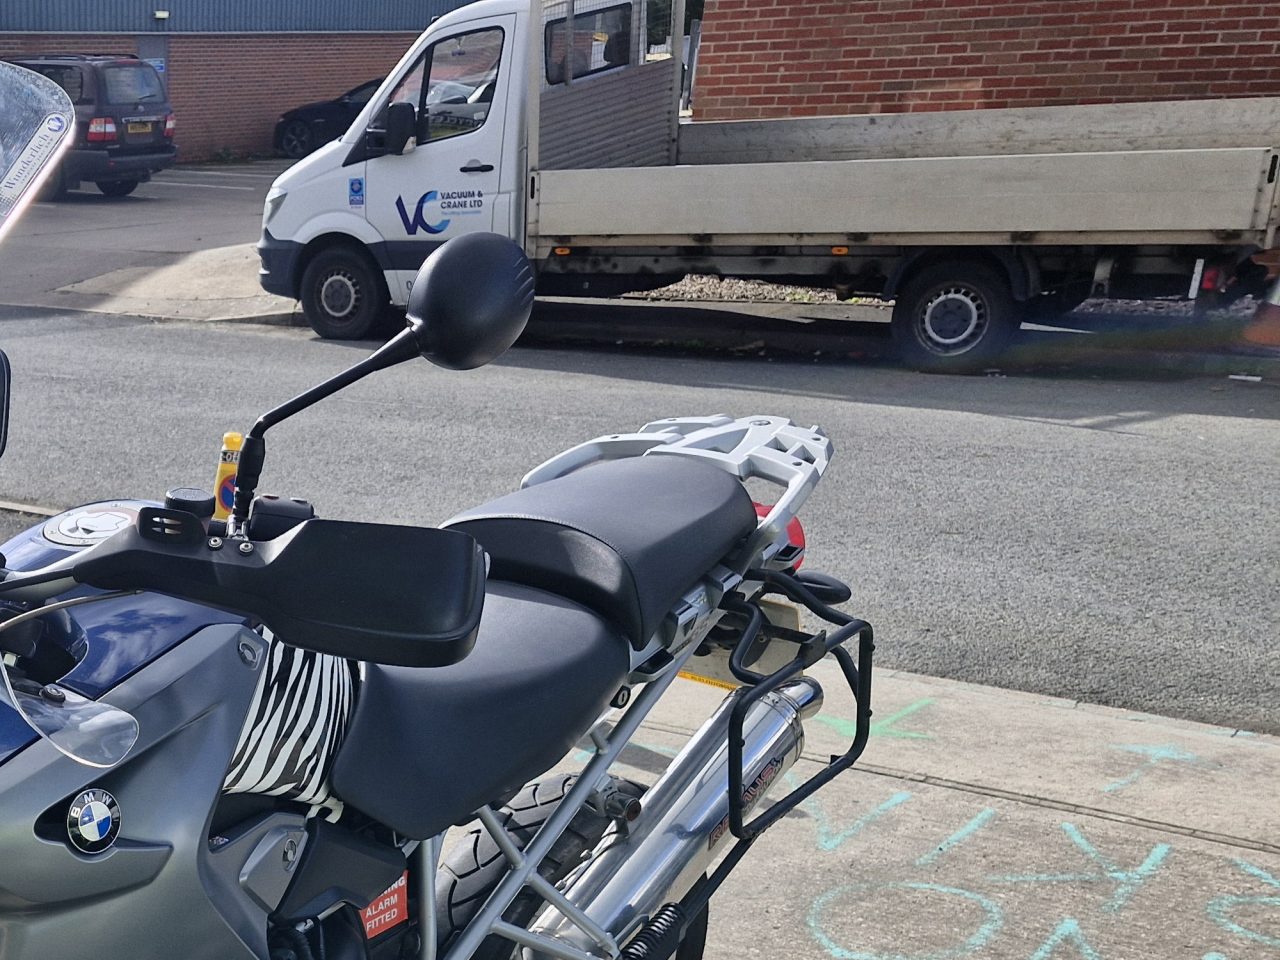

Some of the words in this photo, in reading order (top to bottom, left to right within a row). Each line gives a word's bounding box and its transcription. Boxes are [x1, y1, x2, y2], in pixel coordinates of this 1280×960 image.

[3, 133, 49, 189] Wunderlich
[440, 191, 475, 200] VACUUM
[475, 190, 483, 198] &
[440, 201, 468, 209] CRANE
[469, 200, 483, 208] LTD
[395, 190, 451, 235] VC
[71, 792, 112, 817] BMW
[366, 894, 398, 918] ALARM
[366, 909, 398, 931] FITTED
